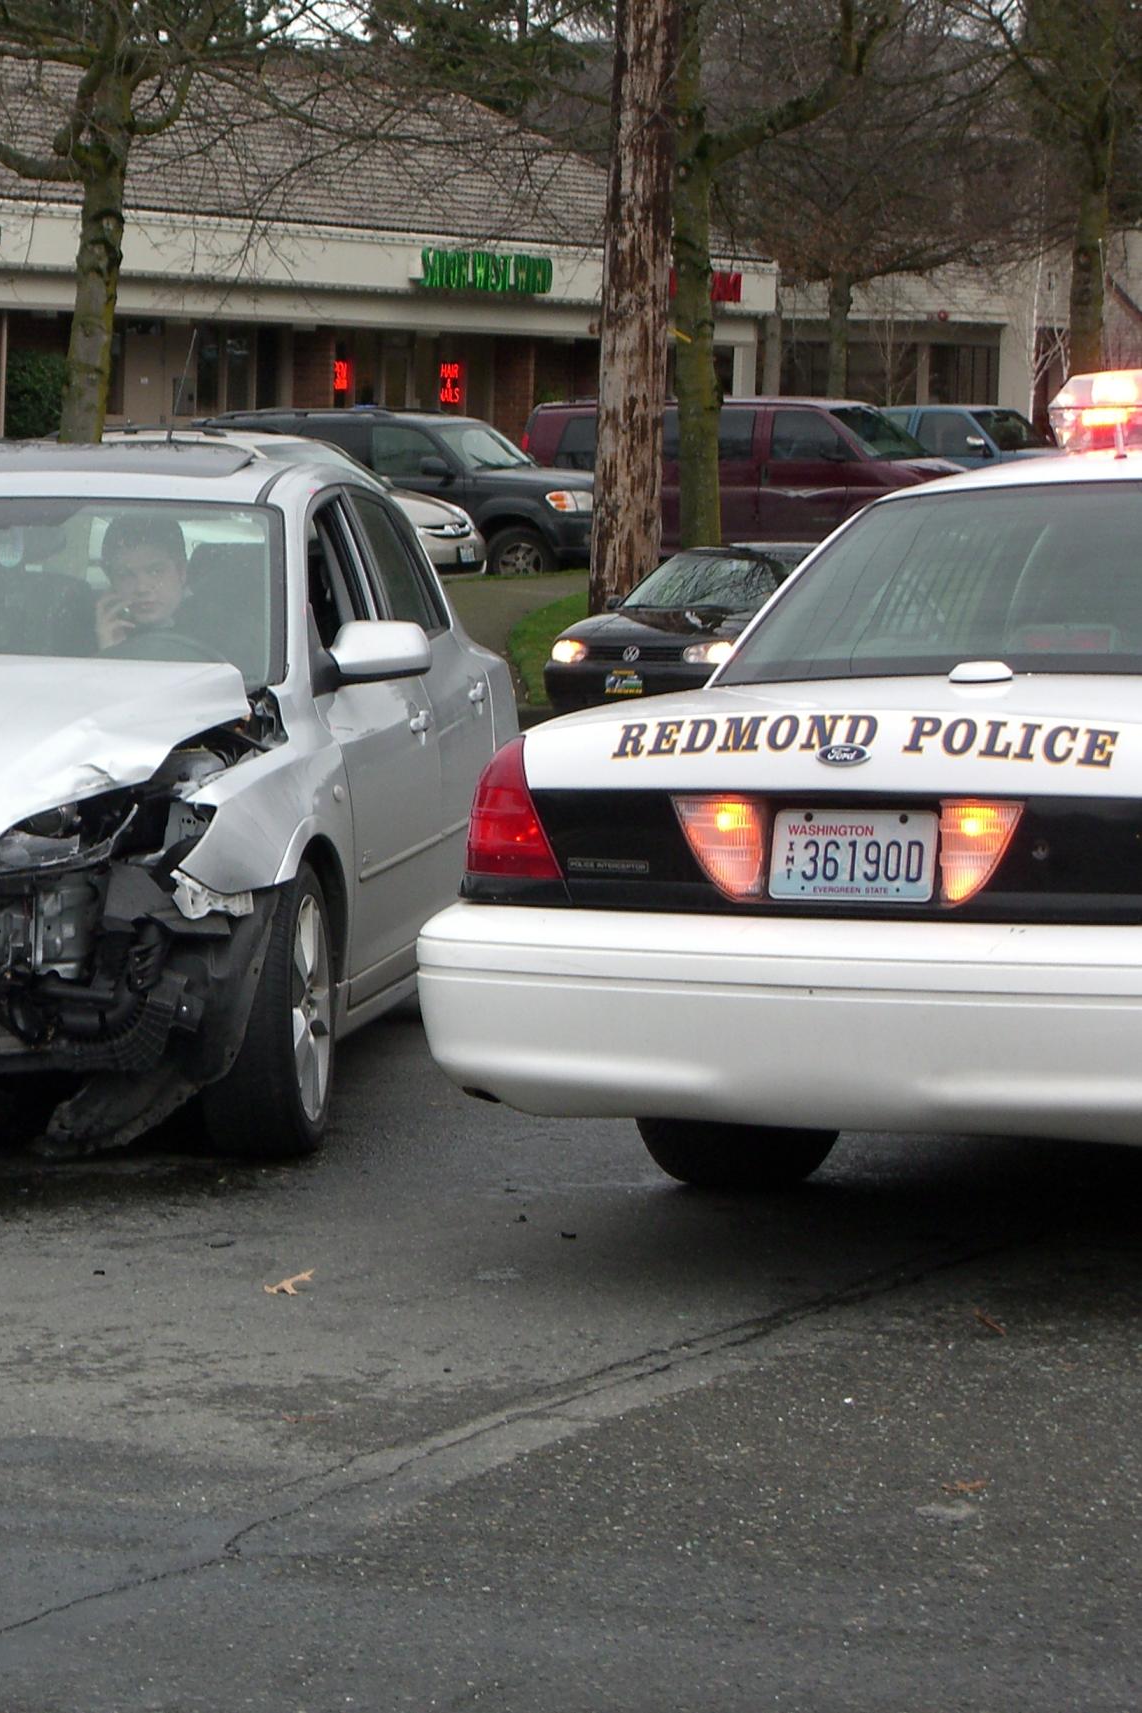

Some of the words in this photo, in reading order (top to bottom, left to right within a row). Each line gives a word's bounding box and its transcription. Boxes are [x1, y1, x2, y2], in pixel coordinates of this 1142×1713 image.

[421, 247, 470, 288] SALON
[472, 251, 513, 292] WEST
[513, 254, 553, 294] WIND
[440, 363, 459, 378] HAIR
[611, 714, 879, 760] REDMOND
[901, 715, 1120, 770] POLICE
[788, 824, 875, 837] WASHINGTON
[813, 886, 861, 895] EVERGREEN
[864, 887, 889, 895] STATE
